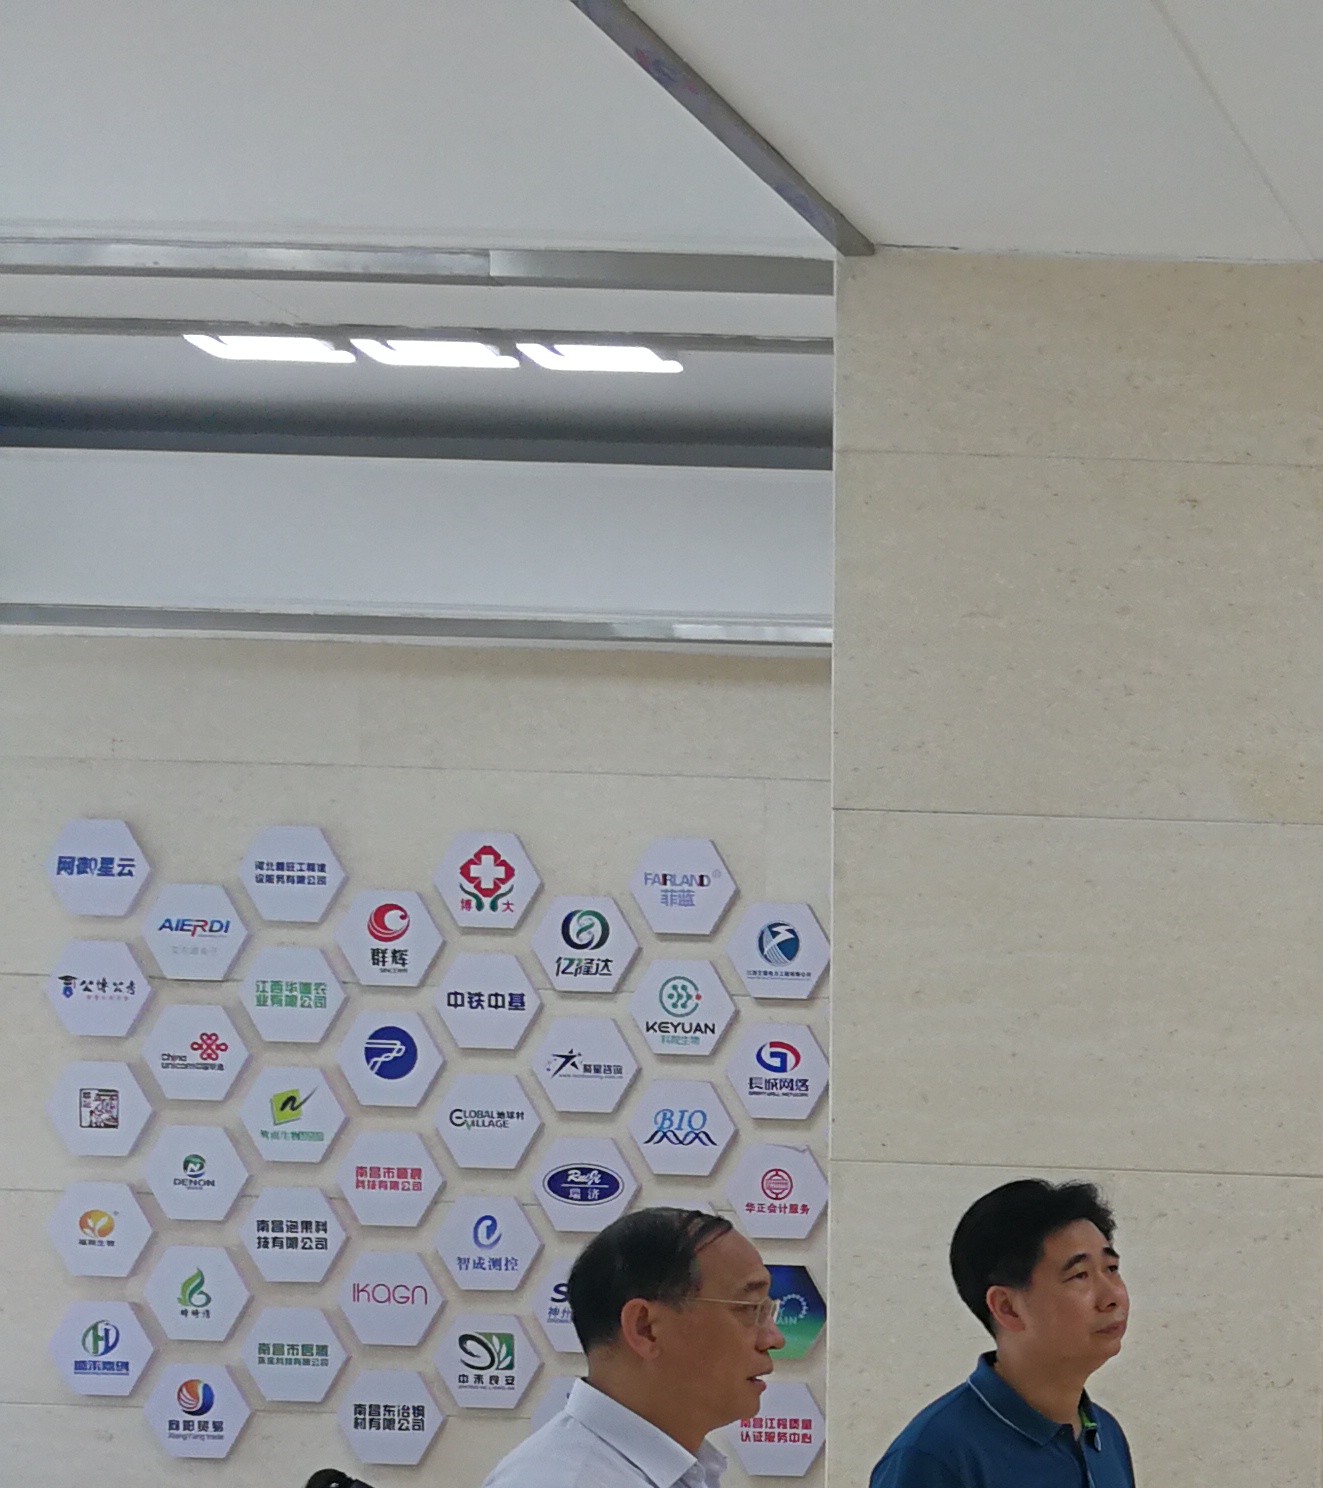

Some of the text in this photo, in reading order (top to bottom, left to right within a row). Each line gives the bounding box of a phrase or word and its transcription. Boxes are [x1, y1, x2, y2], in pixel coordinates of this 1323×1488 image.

[447, 991, 526, 1010] 中铁中基
[646, 1022, 716, 1034] KEYUAN
[654, 1108, 708, 1131] BIO
[745, 1203, 810, 1214] 华正会计服务
